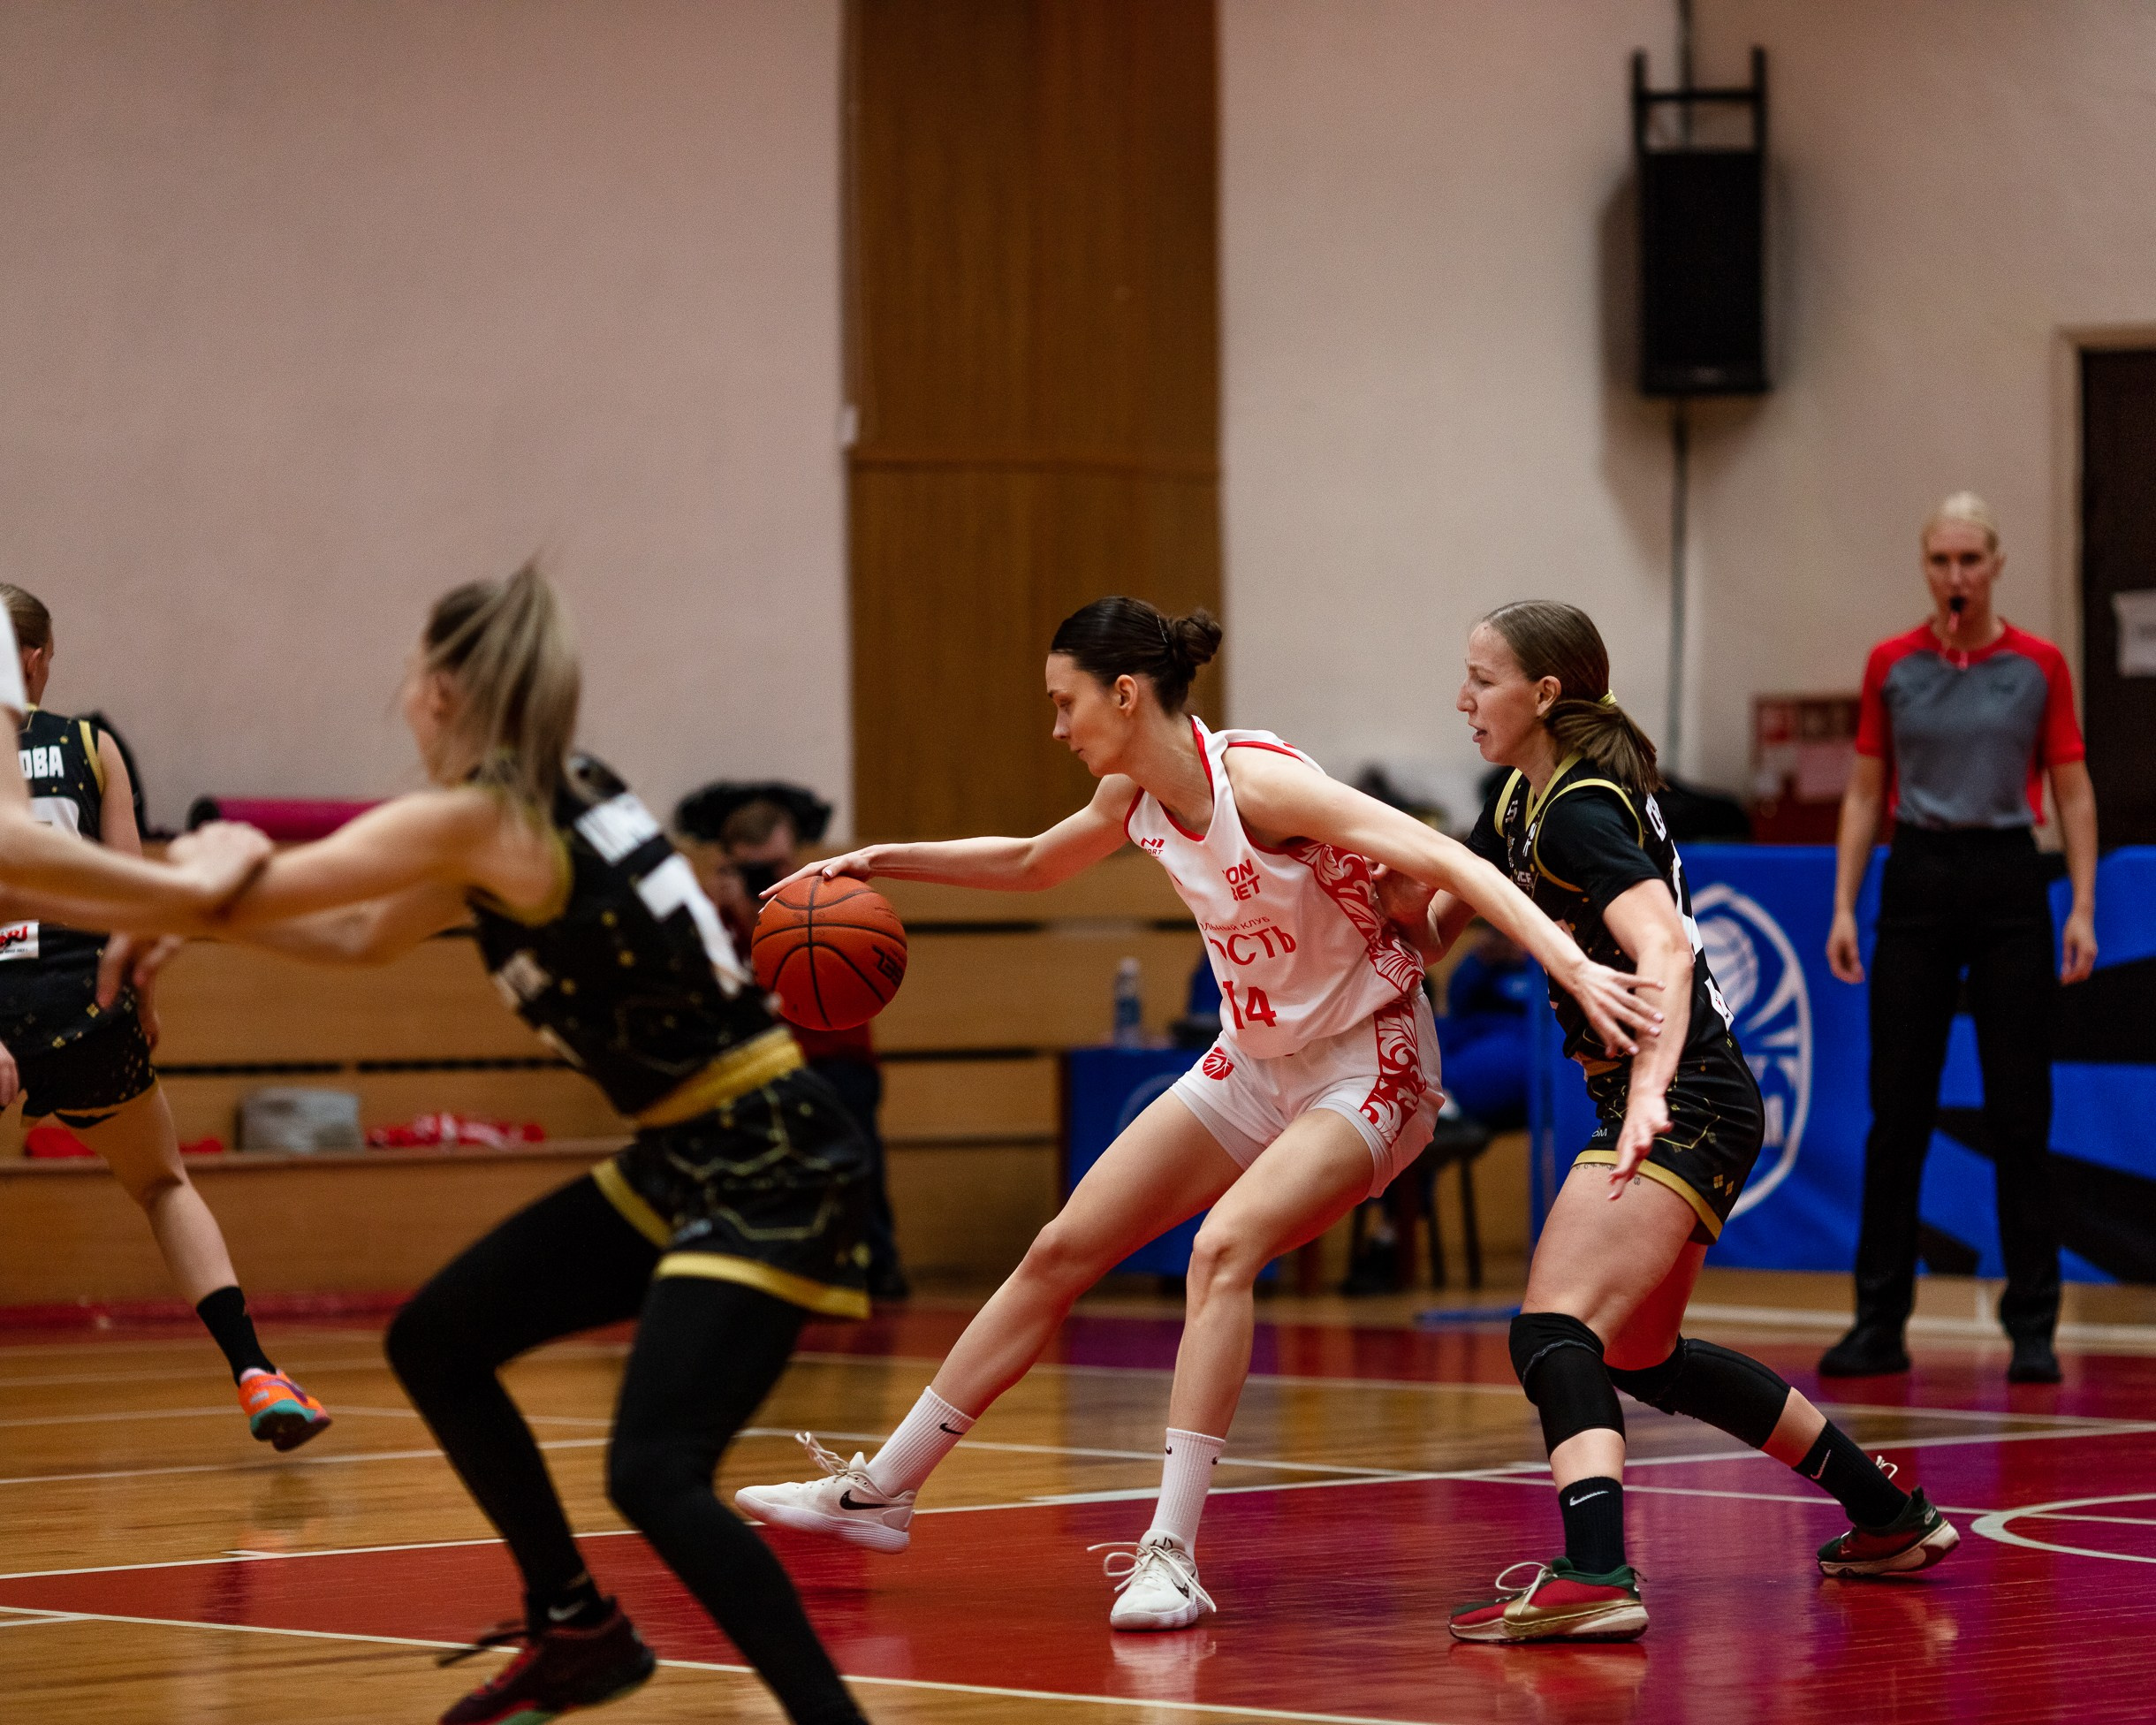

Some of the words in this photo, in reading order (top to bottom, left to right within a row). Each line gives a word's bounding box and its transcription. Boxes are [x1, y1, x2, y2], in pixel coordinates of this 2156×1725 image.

[1221, 858, 1255, 885] ON
[1240, 916, 1271, 930] КЛУБ
[1222, 980, 1278, 1030] 14
